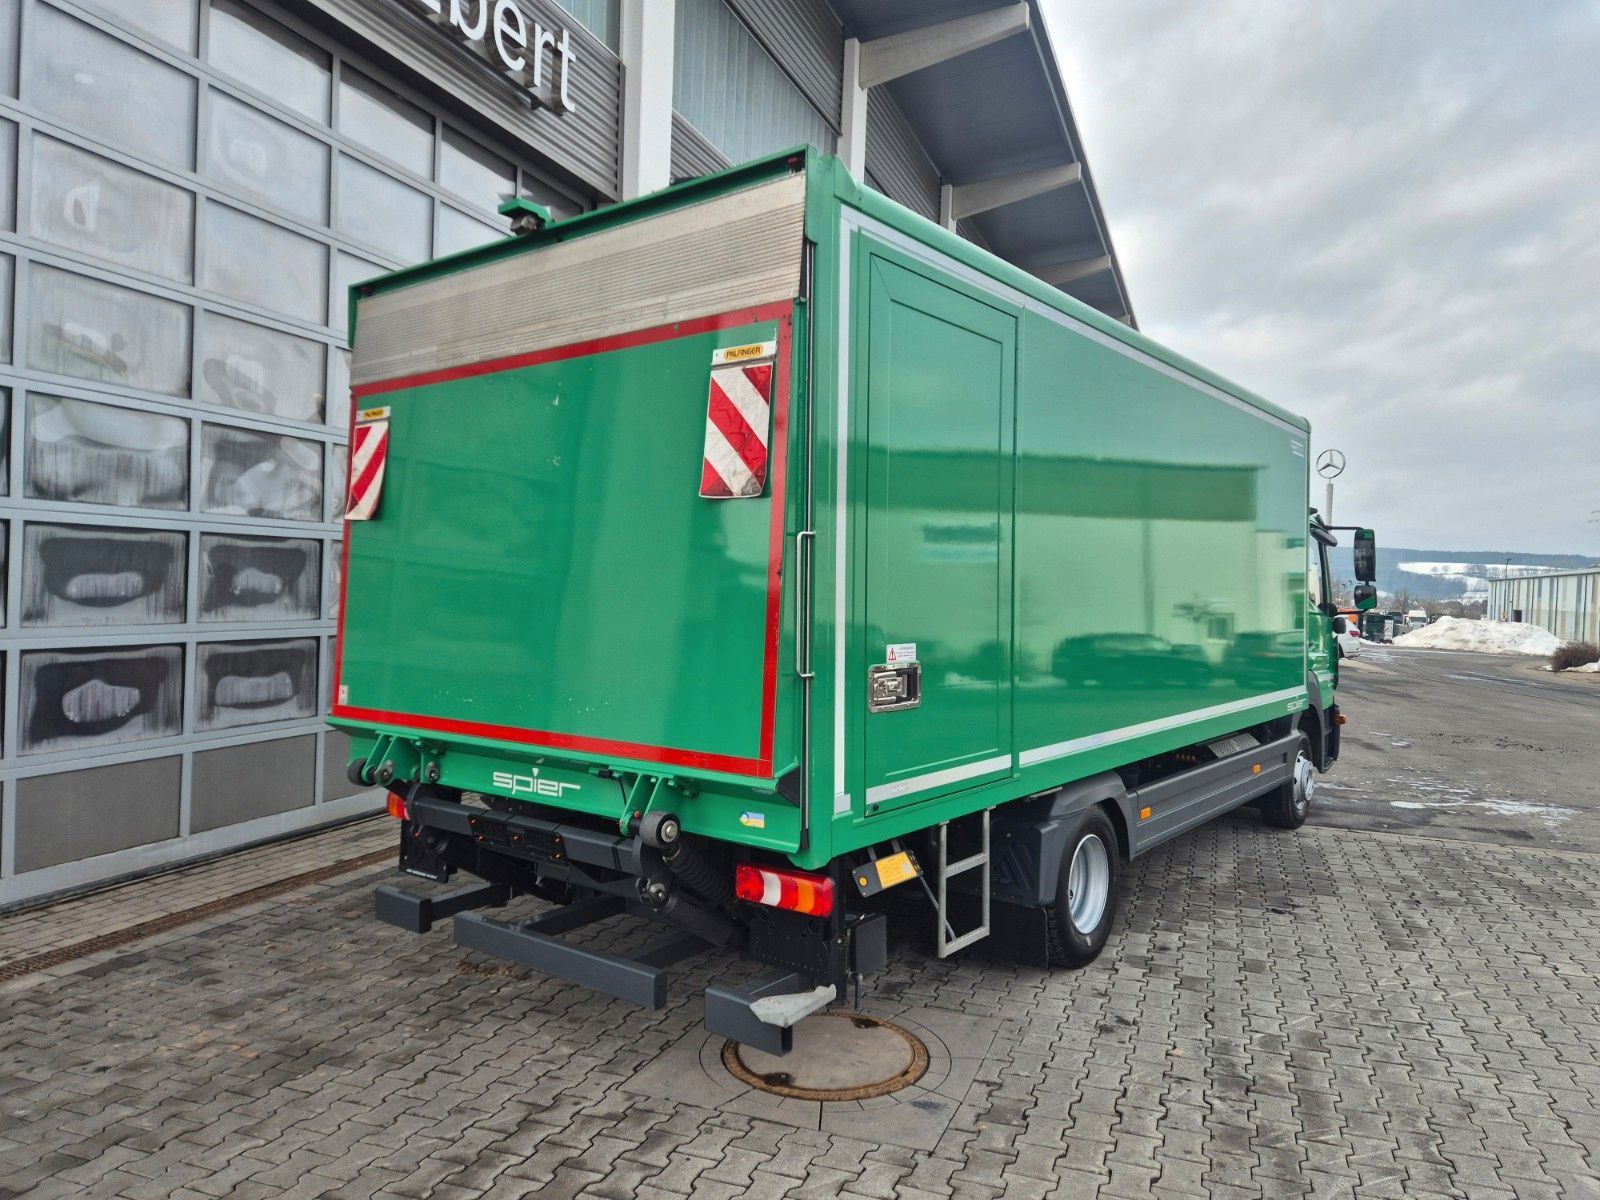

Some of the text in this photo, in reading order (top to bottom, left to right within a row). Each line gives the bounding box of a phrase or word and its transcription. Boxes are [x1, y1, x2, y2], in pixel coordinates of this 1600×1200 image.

[421, 0, 576, 112] ert
[726, 346, 761, 358] PALFINGER
[493, 768, 581, 797] spier
